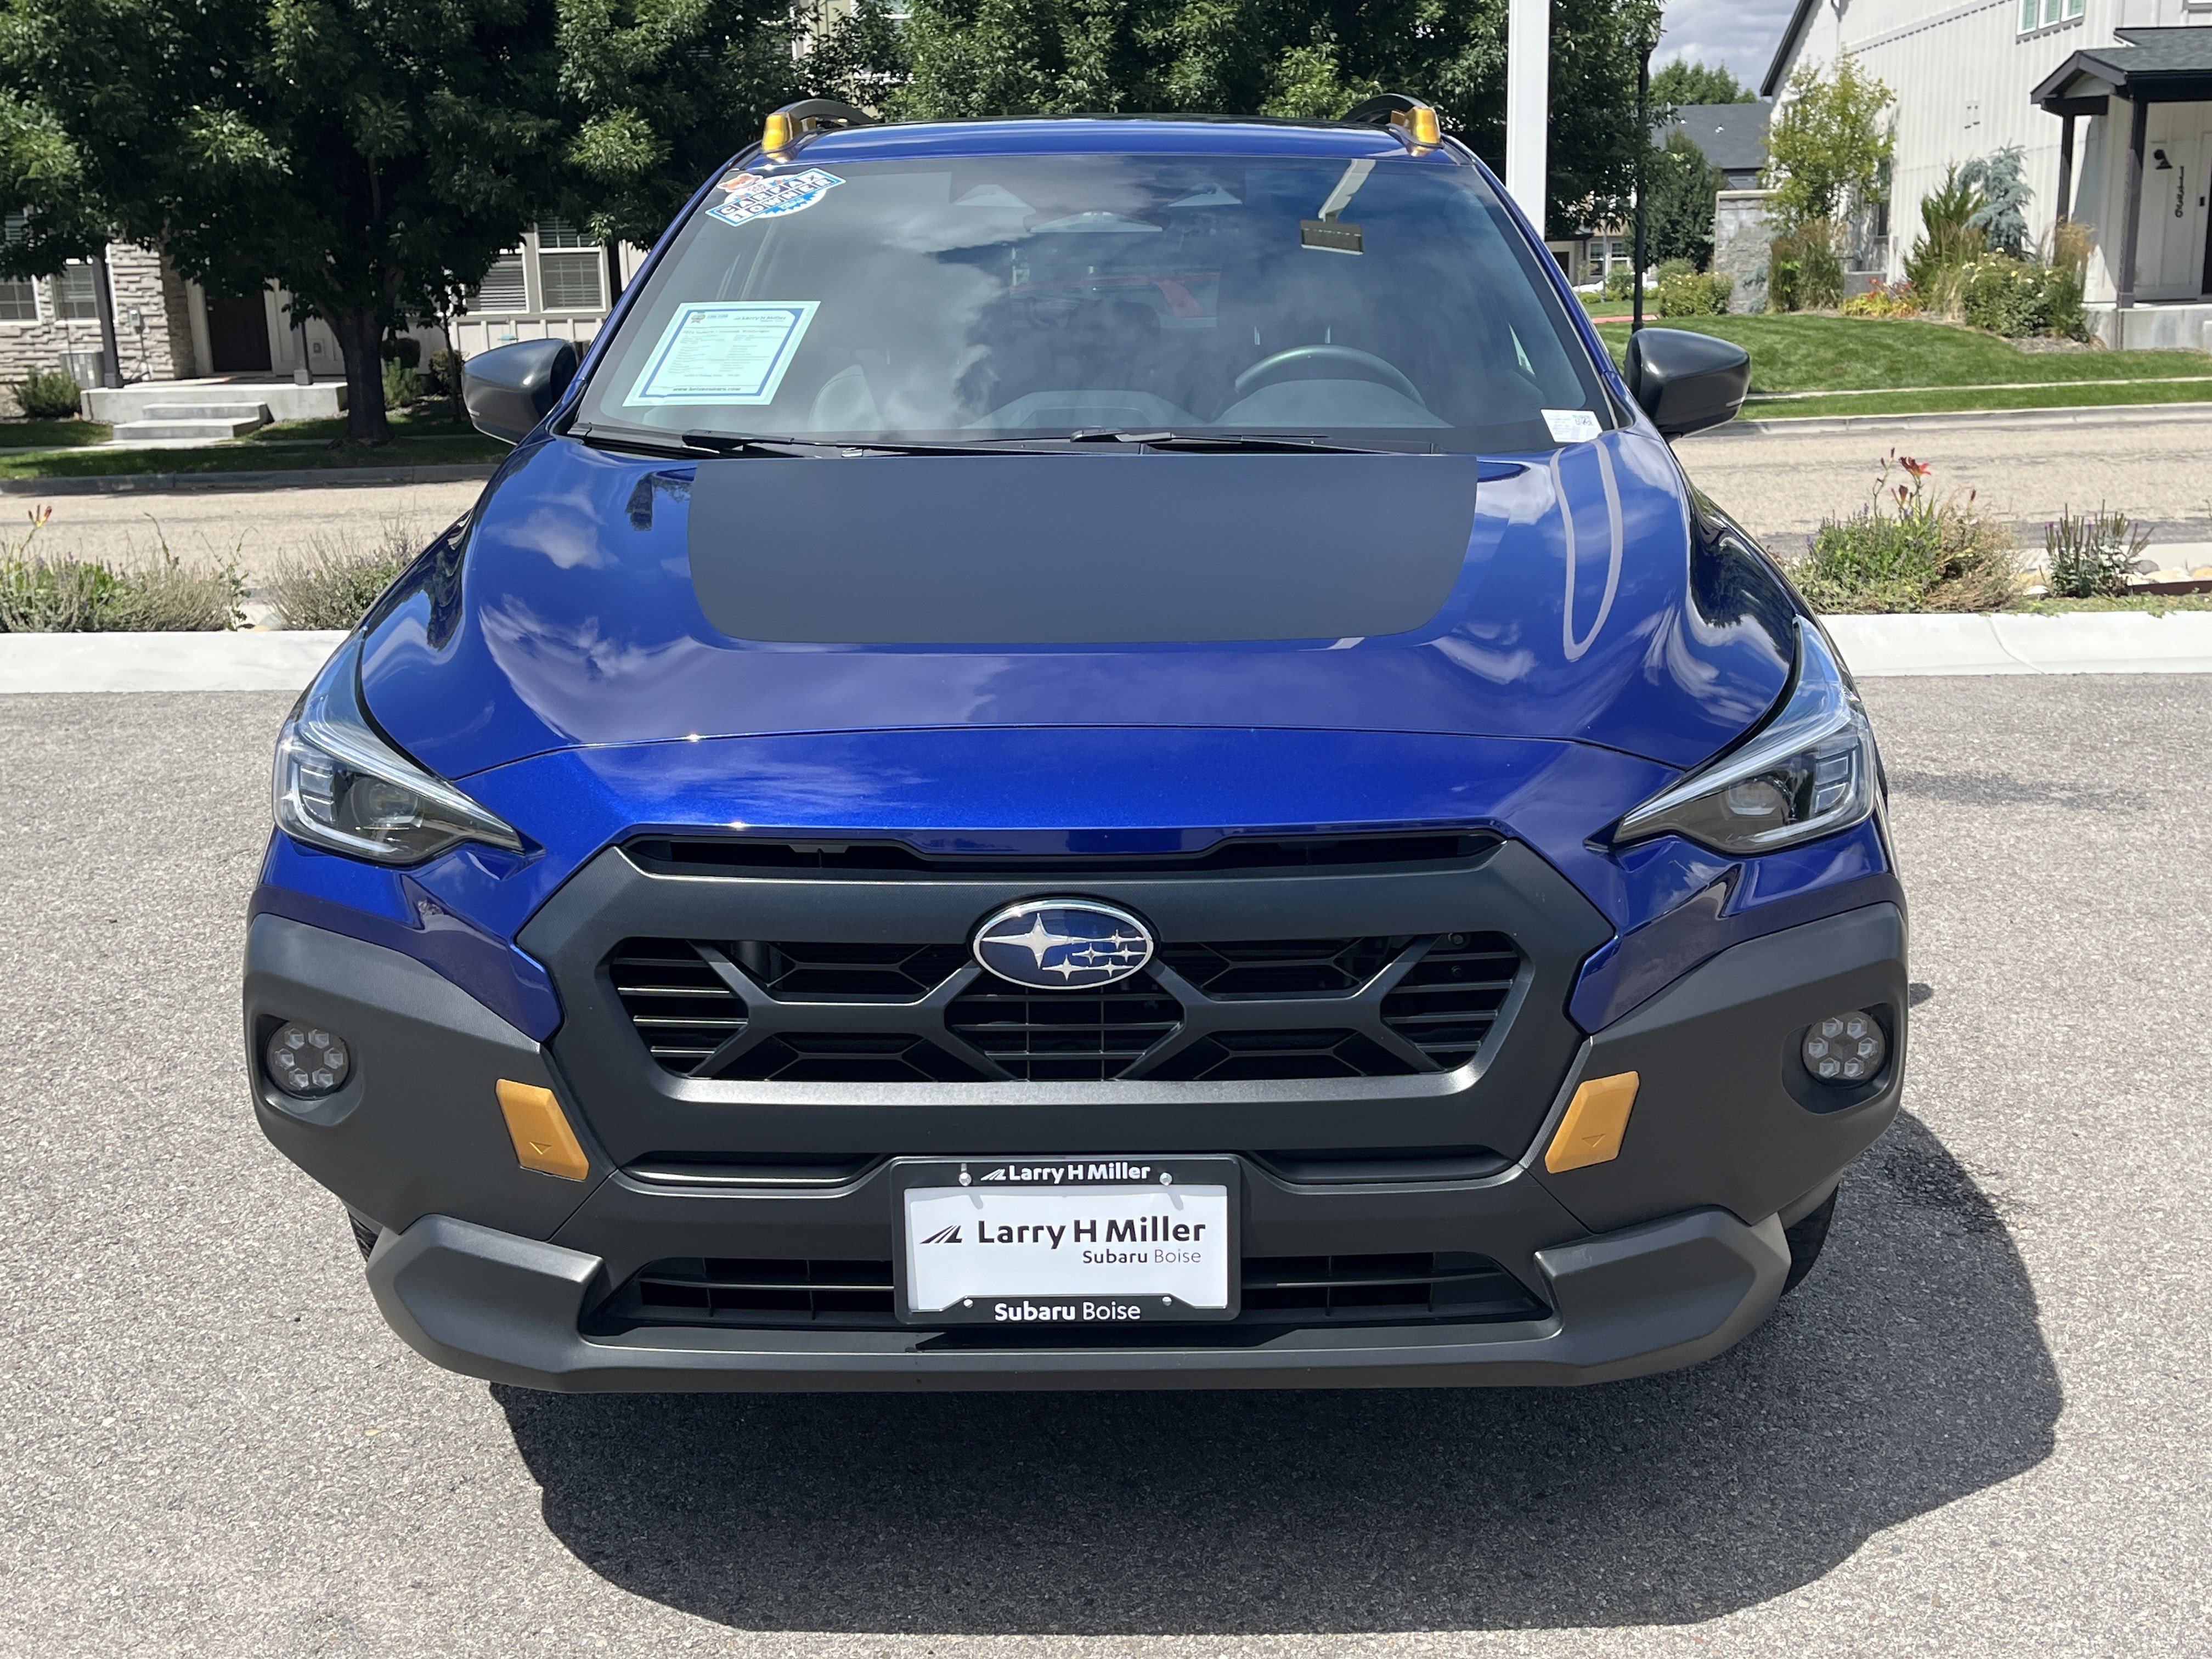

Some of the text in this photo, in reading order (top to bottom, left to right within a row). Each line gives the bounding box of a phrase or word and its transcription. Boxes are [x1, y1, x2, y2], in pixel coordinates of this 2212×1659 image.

[745, 178, 833, 213] OWNER
[1009, 1162, 1150, 1184] Larry H Miller
[978, 1216, 1206, 1250] Larry H Miller
[1082, 1248, 1201, 1264] Subaru Boise
[995, 1300, 1141, 1321] Subaru Boise
